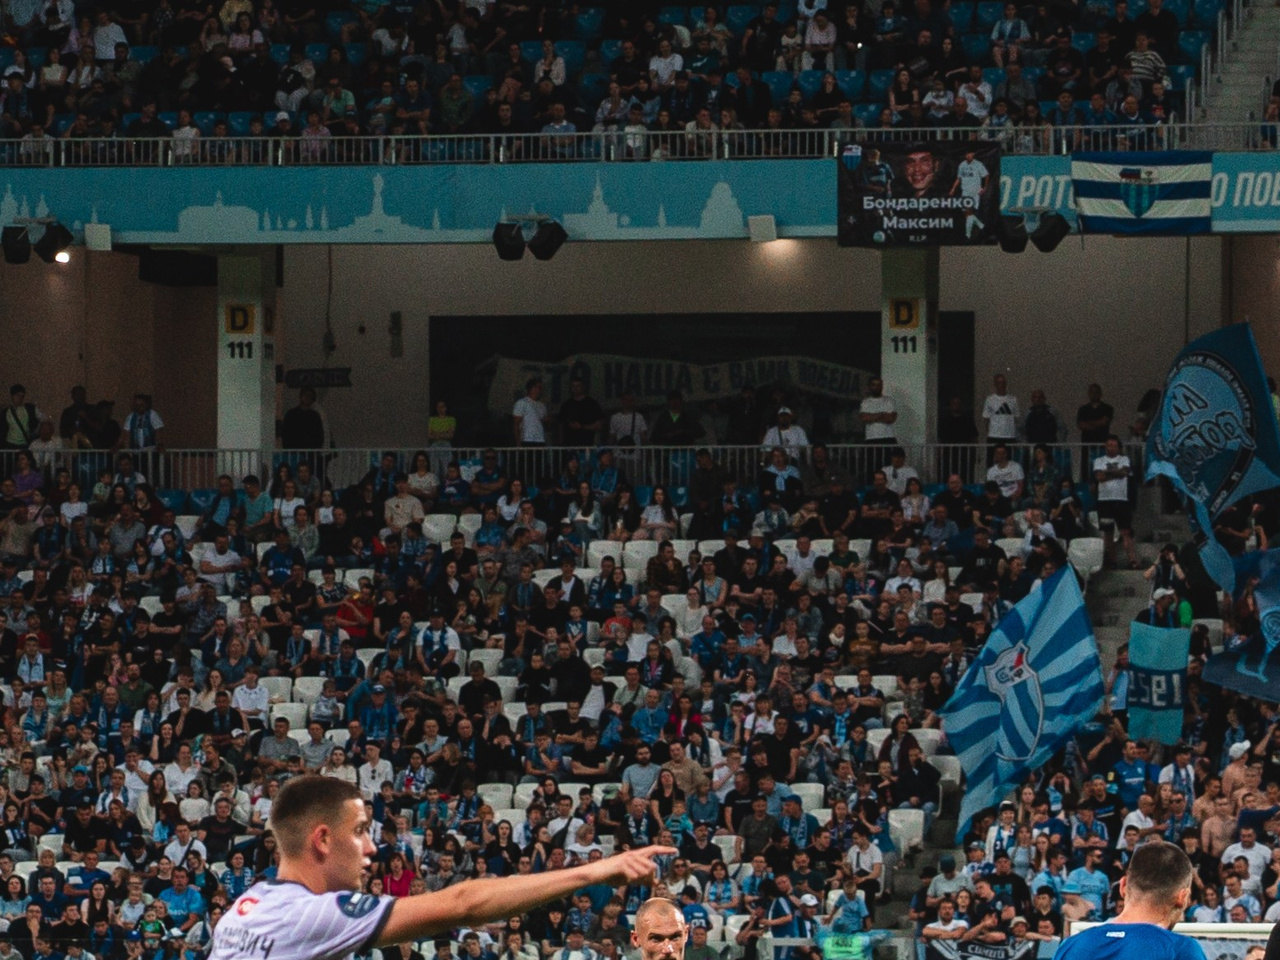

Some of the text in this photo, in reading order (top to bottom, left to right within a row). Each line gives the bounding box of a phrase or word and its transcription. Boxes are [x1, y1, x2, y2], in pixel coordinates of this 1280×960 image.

[863, 196, 974, 212] Бондаренко
[883, 216, 954, 230] Максим
[230, 306, 249, 331] D
[895, 301, 913, 325] D
[227, 341, 253, 358] 111
[891, 336, 917, 353] 111
[605, 361, 695, 398] НАША
